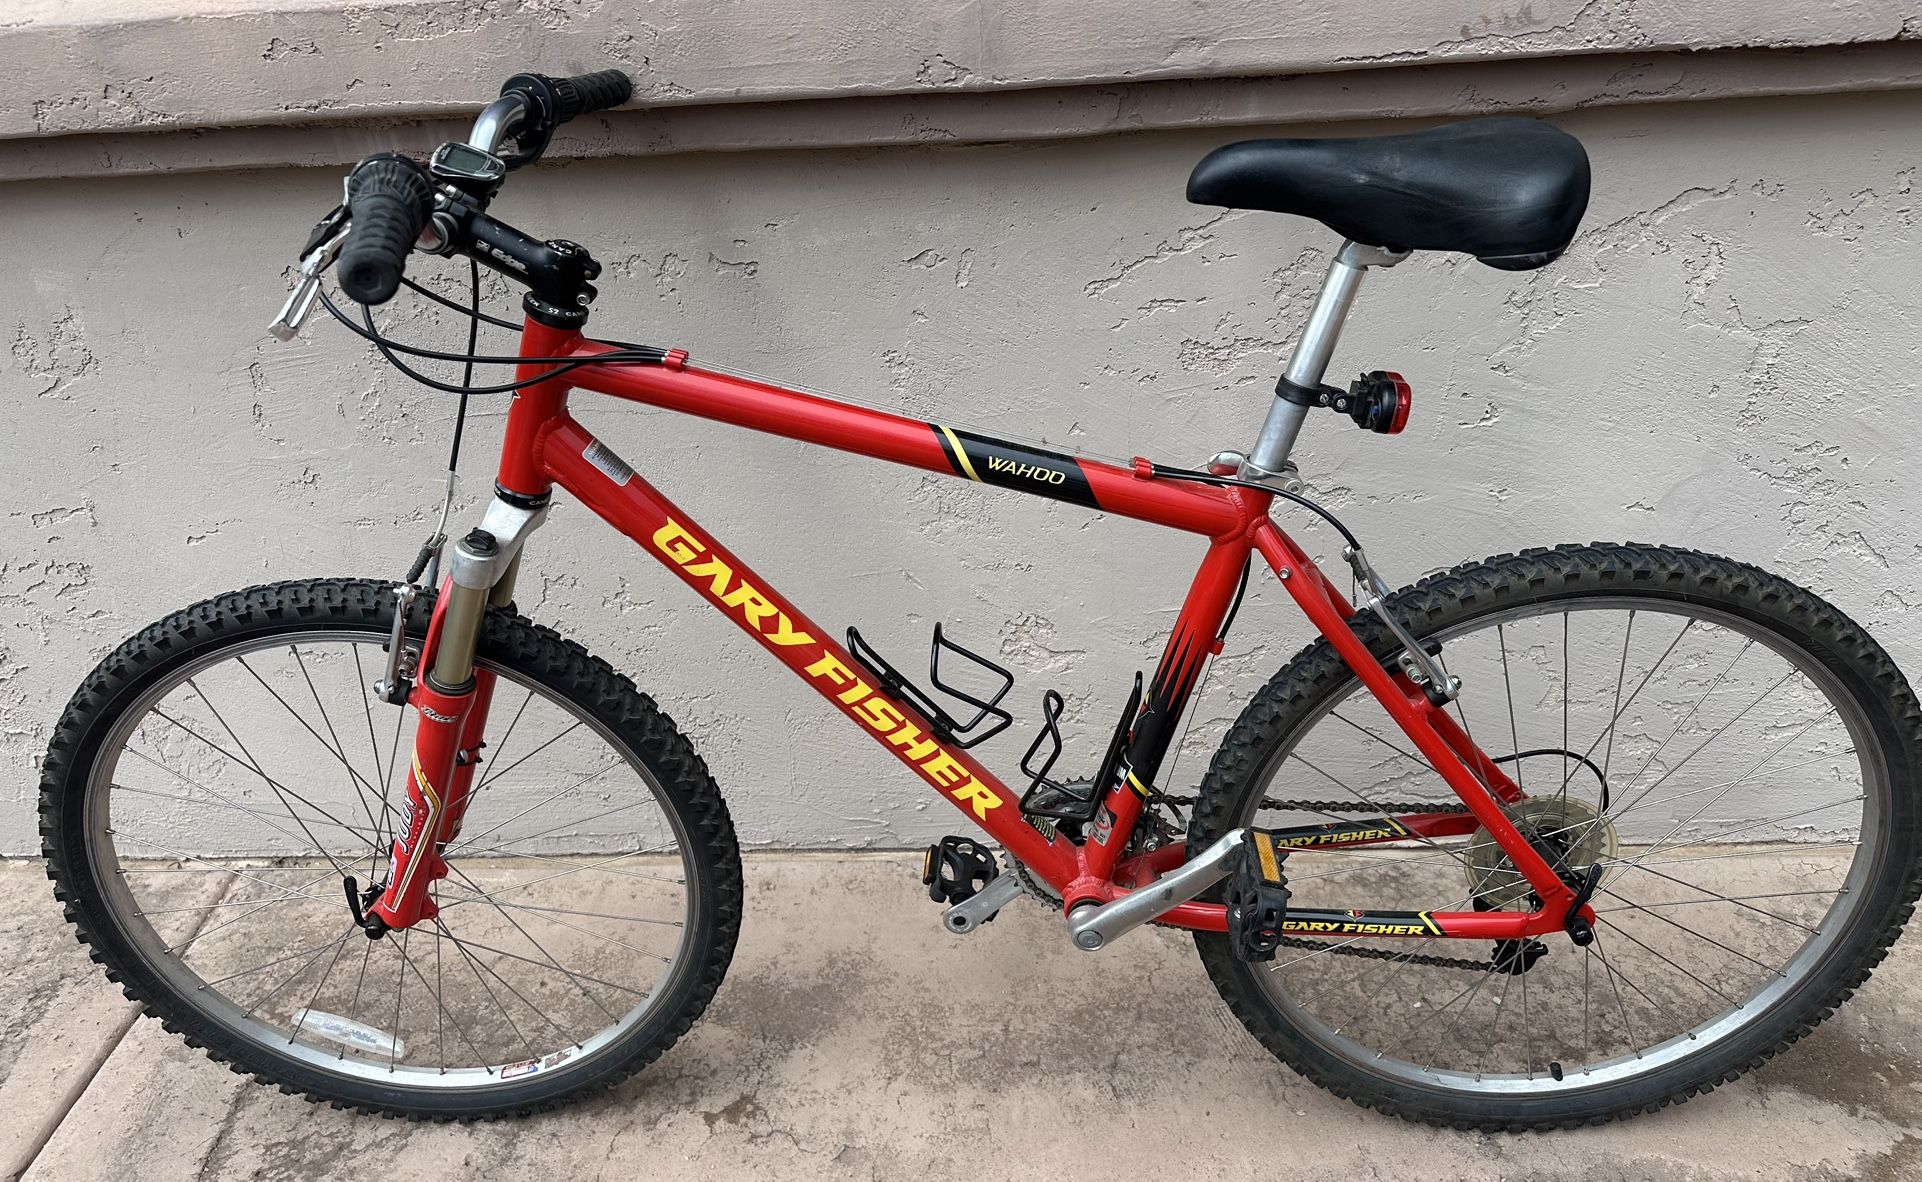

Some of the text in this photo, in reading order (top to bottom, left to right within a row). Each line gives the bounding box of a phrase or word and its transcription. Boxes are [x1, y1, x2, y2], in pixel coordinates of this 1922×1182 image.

[548, 306, 560, 315] S2
[988, 456, 1066, 485] WAHOO
[652, 516, 1003, 821] GARY FISHER
[1279, 836, 1317, 847] ARY
[1281, 921, 1425, 935] GARY FISHER
